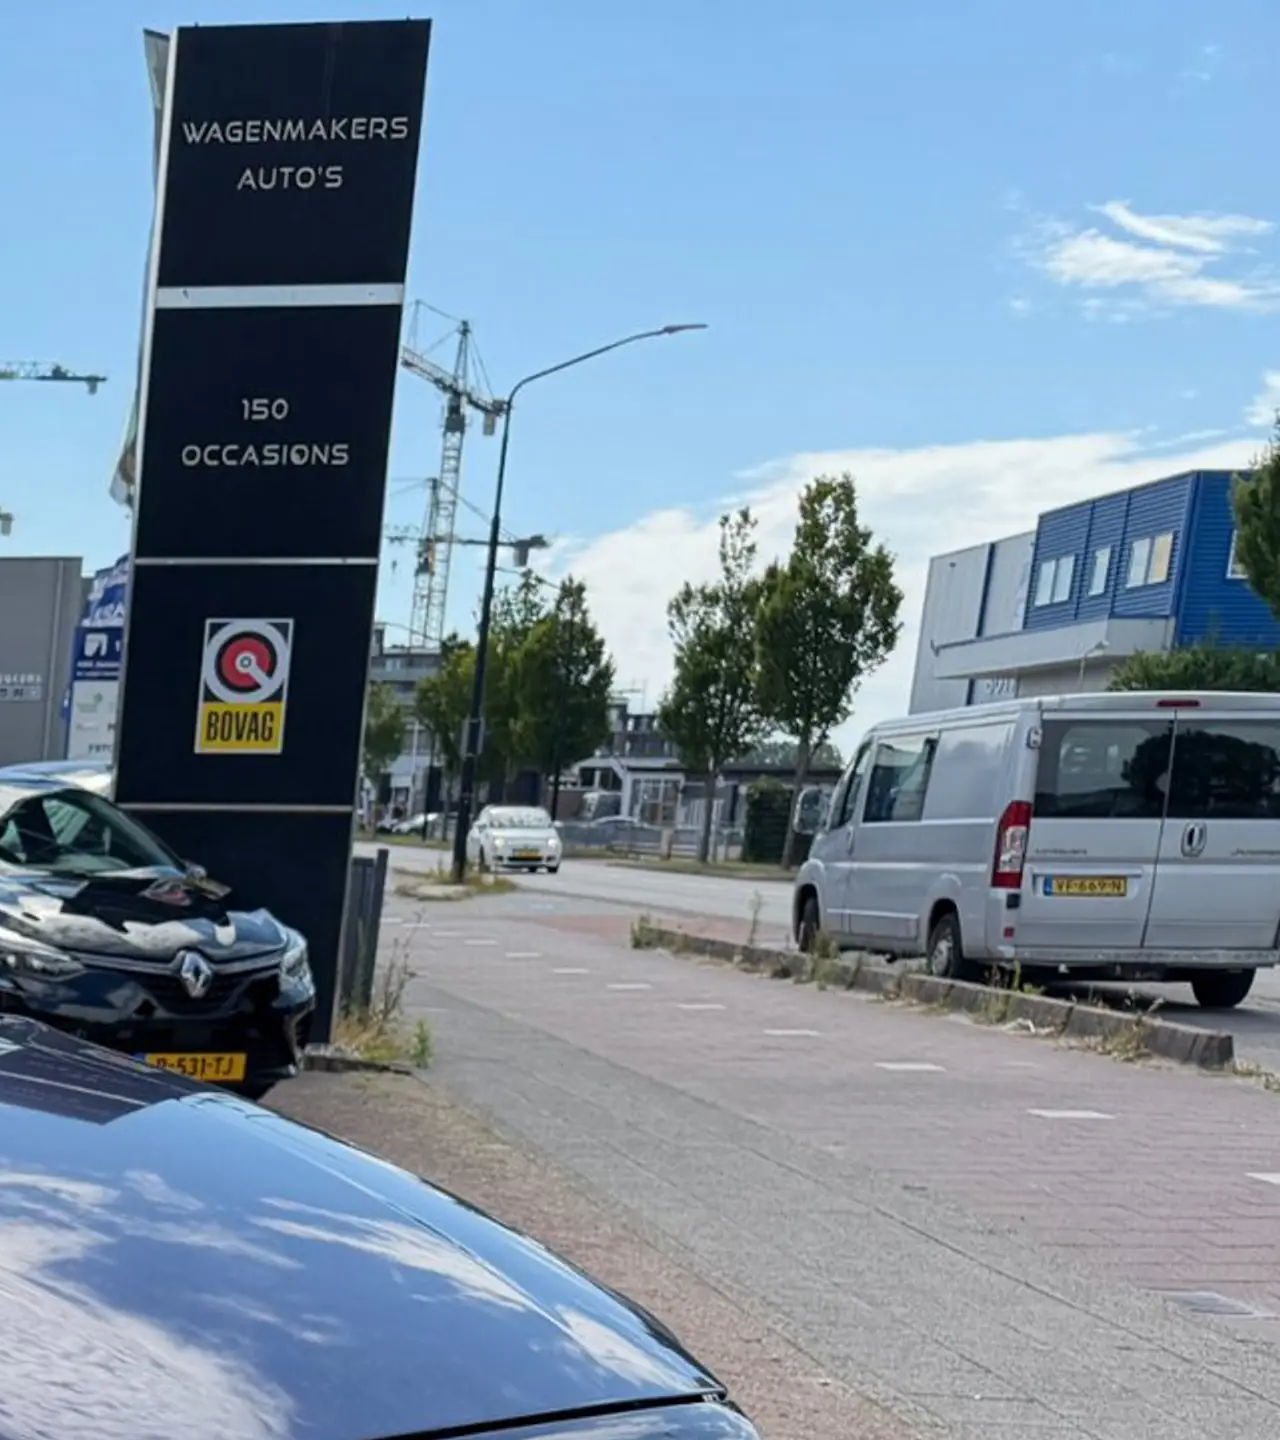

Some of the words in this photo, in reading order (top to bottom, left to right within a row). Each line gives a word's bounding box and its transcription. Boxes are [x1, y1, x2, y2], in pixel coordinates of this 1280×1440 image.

[183, 117, 409, 144] WAGENMAKERS
[237, 166, 343, 190] AUTO'S
[242, 398, 289, 421] 150
[181, 444, 350, 466] OCCASIONS
[206, 710, 275, 742] BOVAG
